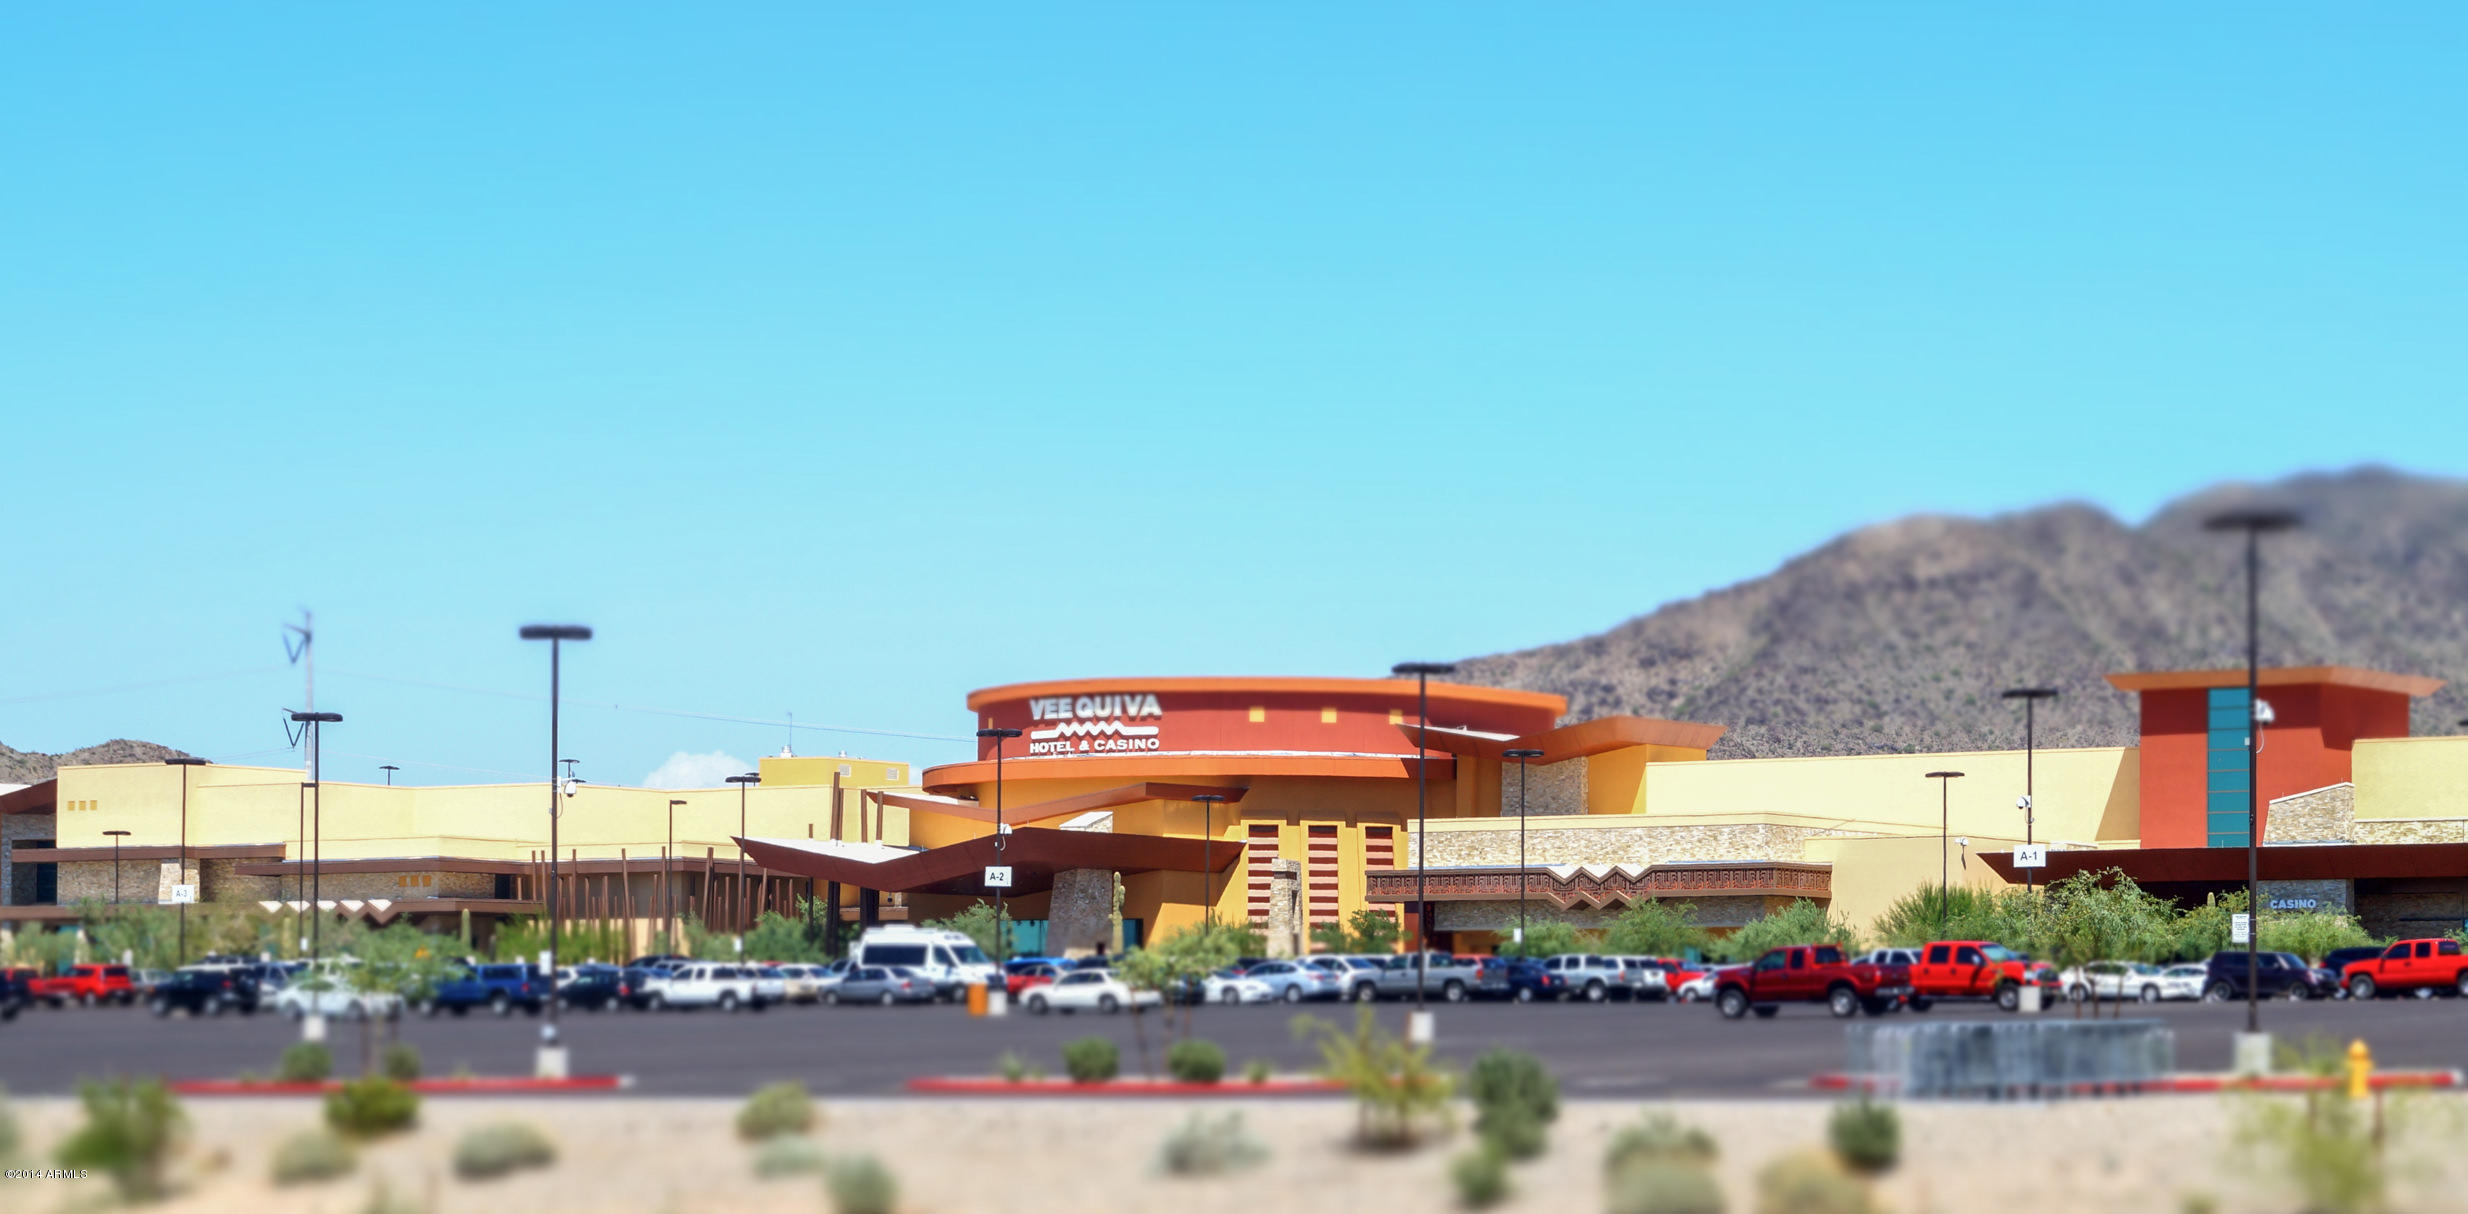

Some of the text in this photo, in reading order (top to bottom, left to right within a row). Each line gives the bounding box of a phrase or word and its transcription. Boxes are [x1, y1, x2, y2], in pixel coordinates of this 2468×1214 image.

[1029, 693, 1163, 720] VEE QUIVA
[1029, 738, 1160, 753] HOTEL & CASINO
[2020, 851, 2038, 861] A-1
[989, 872, 1005, 881] A-2
[2269, 899, 2317, 909] CASINO
